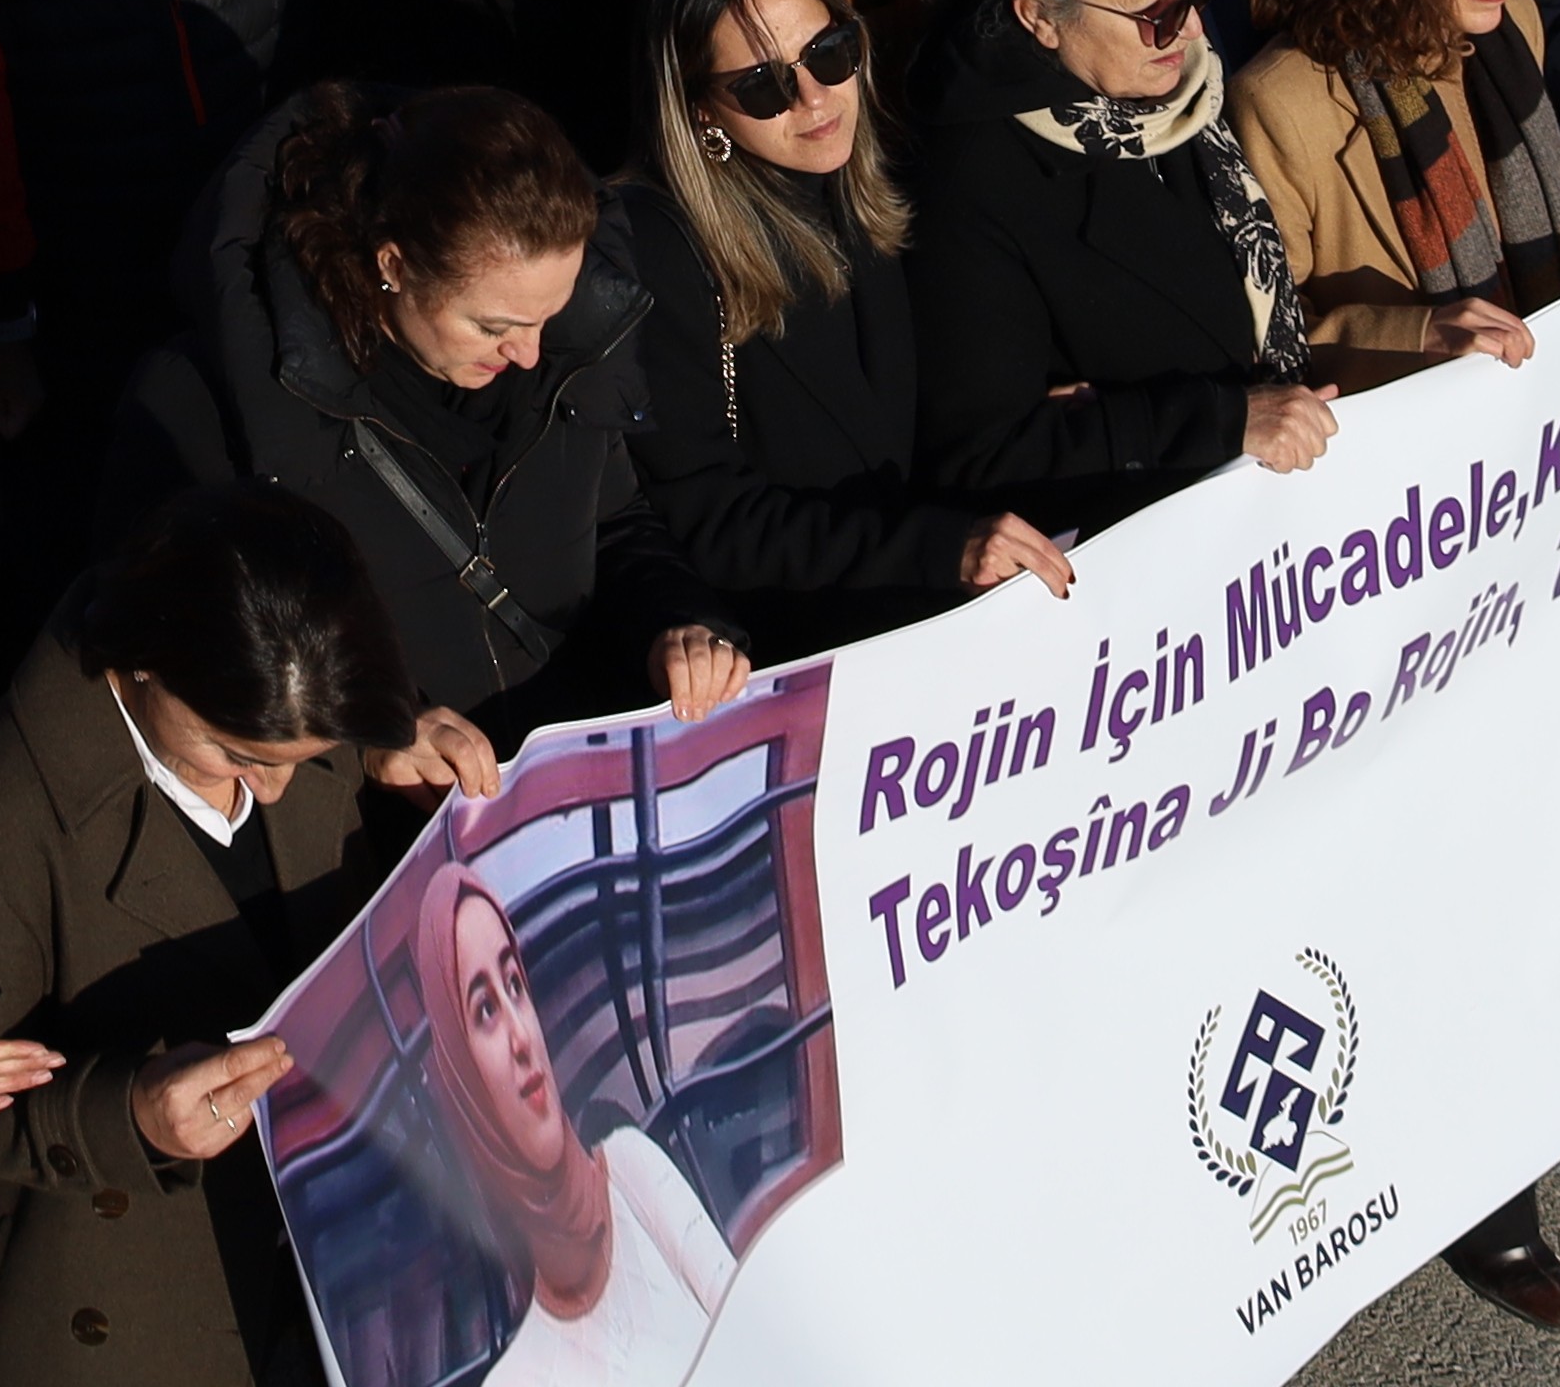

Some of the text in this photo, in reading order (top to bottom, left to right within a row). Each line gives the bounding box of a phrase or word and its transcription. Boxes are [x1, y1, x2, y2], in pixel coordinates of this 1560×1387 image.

[859, 698, 1056, 837] Rojin
[1080, 627, 1205, 764] İçin
[869, 784, 1191, 990] Tekoşîna
[1209, 717, 1278, 817] Ji
[1284, 685, 1372, 778] Bo
[1236, 1184, 1401, 1335] VAN BAROSU
[1287, 1198, 1329, 1246] 1967
